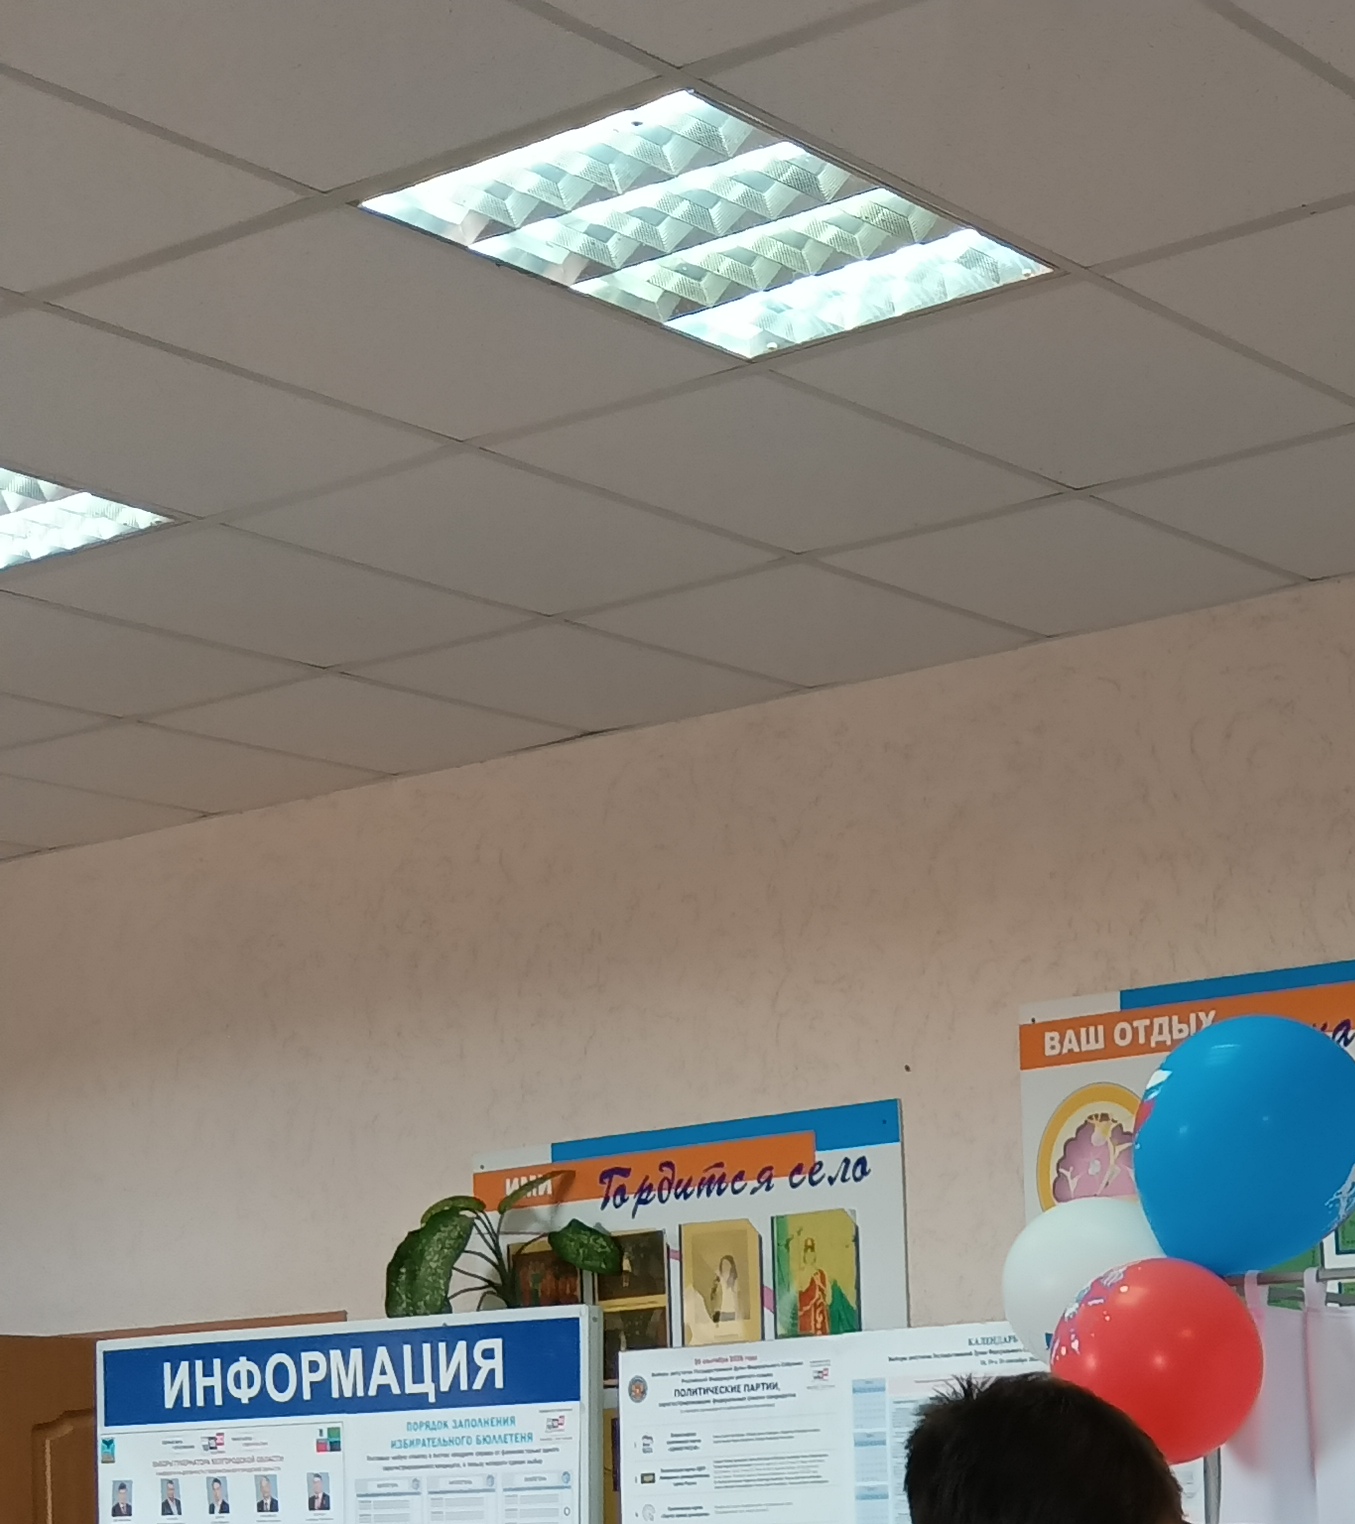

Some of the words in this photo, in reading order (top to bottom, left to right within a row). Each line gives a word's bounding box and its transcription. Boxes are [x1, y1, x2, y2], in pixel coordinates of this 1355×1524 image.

[1044, 1025, 1105, 1057] ВАШ
[1113, 1010, 1217, 1048] ОТДЫХ
[599, 1159, 775, 1219] Гордится
[788, 1154, 871, 1189] село
[162, 1337, 504, 1409] ИНФОРМАЦИЯ
[674, 1383, 742, 1398] ПОЛИТИЧЕСКИЕ
